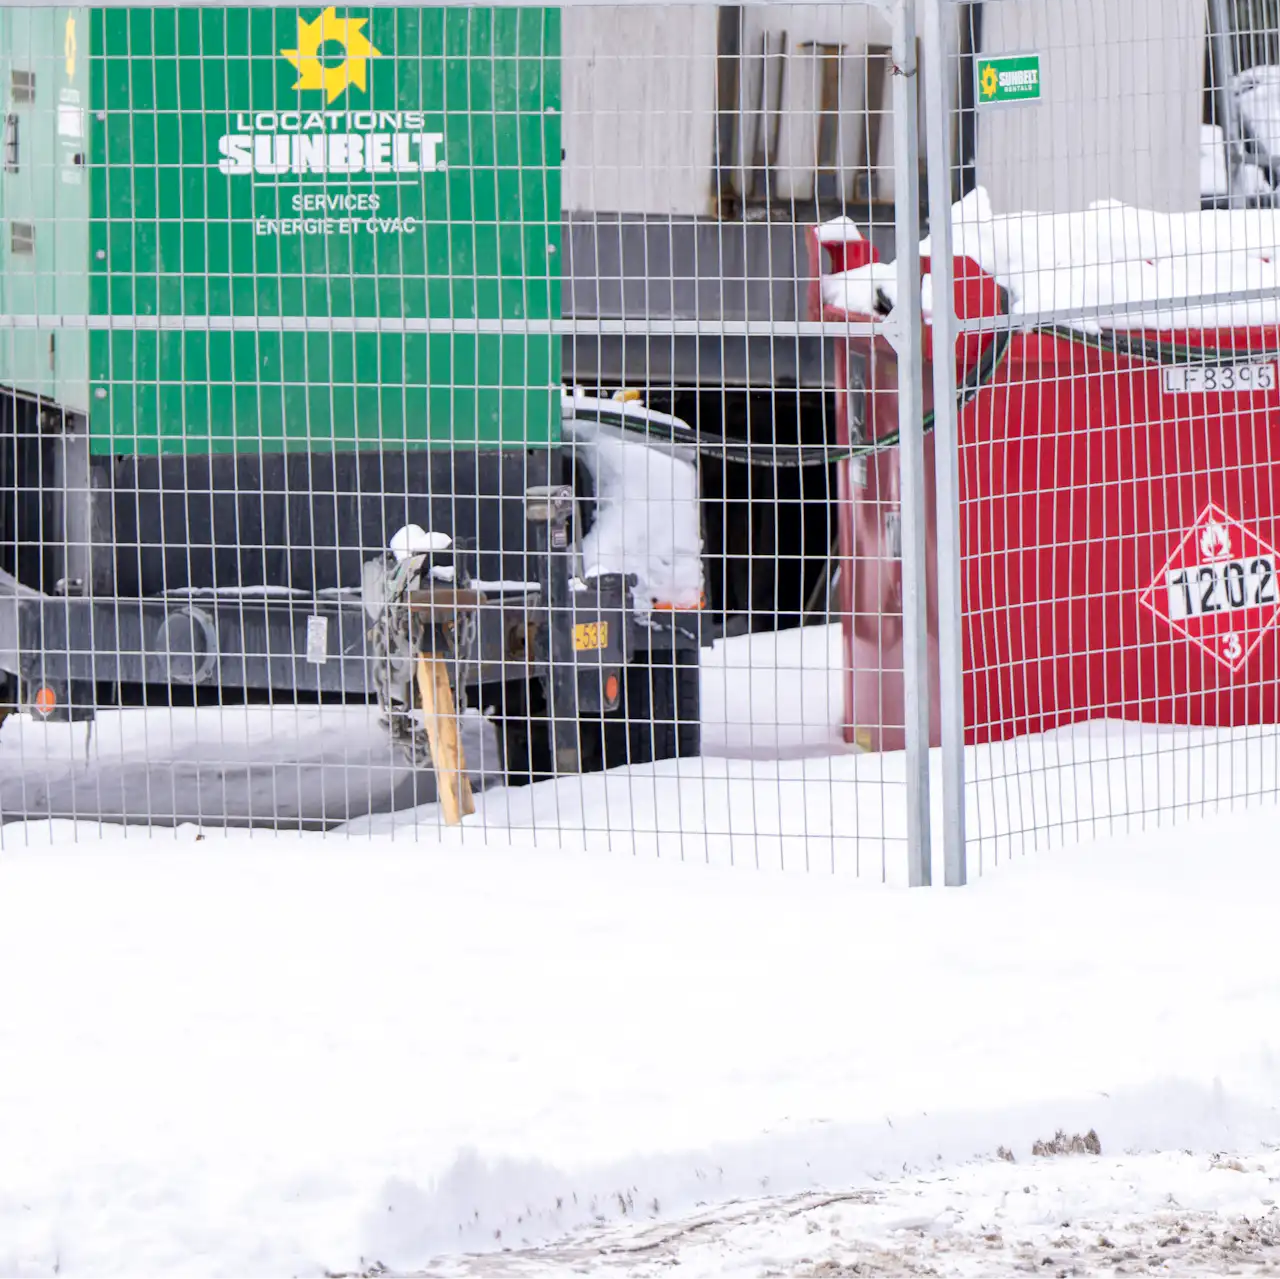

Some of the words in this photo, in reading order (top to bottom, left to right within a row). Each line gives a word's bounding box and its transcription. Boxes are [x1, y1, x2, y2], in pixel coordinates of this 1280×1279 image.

[999, 69, 1038, 86] SUNBELT
[236, 111, 426, 131] LOCATIONS
[218, 132, 444, 175] SUNBELT
[291, 193, 381, 211] SERVICES
[255, 215, 334, 236] ÉNERGIE
[338, 218, 361, 234] ET
[365, 216, 416, 234] CVAC
[1166, 366, 1272, 391] LF8395
[1172, 558, 1275, 616] 1202
[1222, 632, 1242, 659] 3
